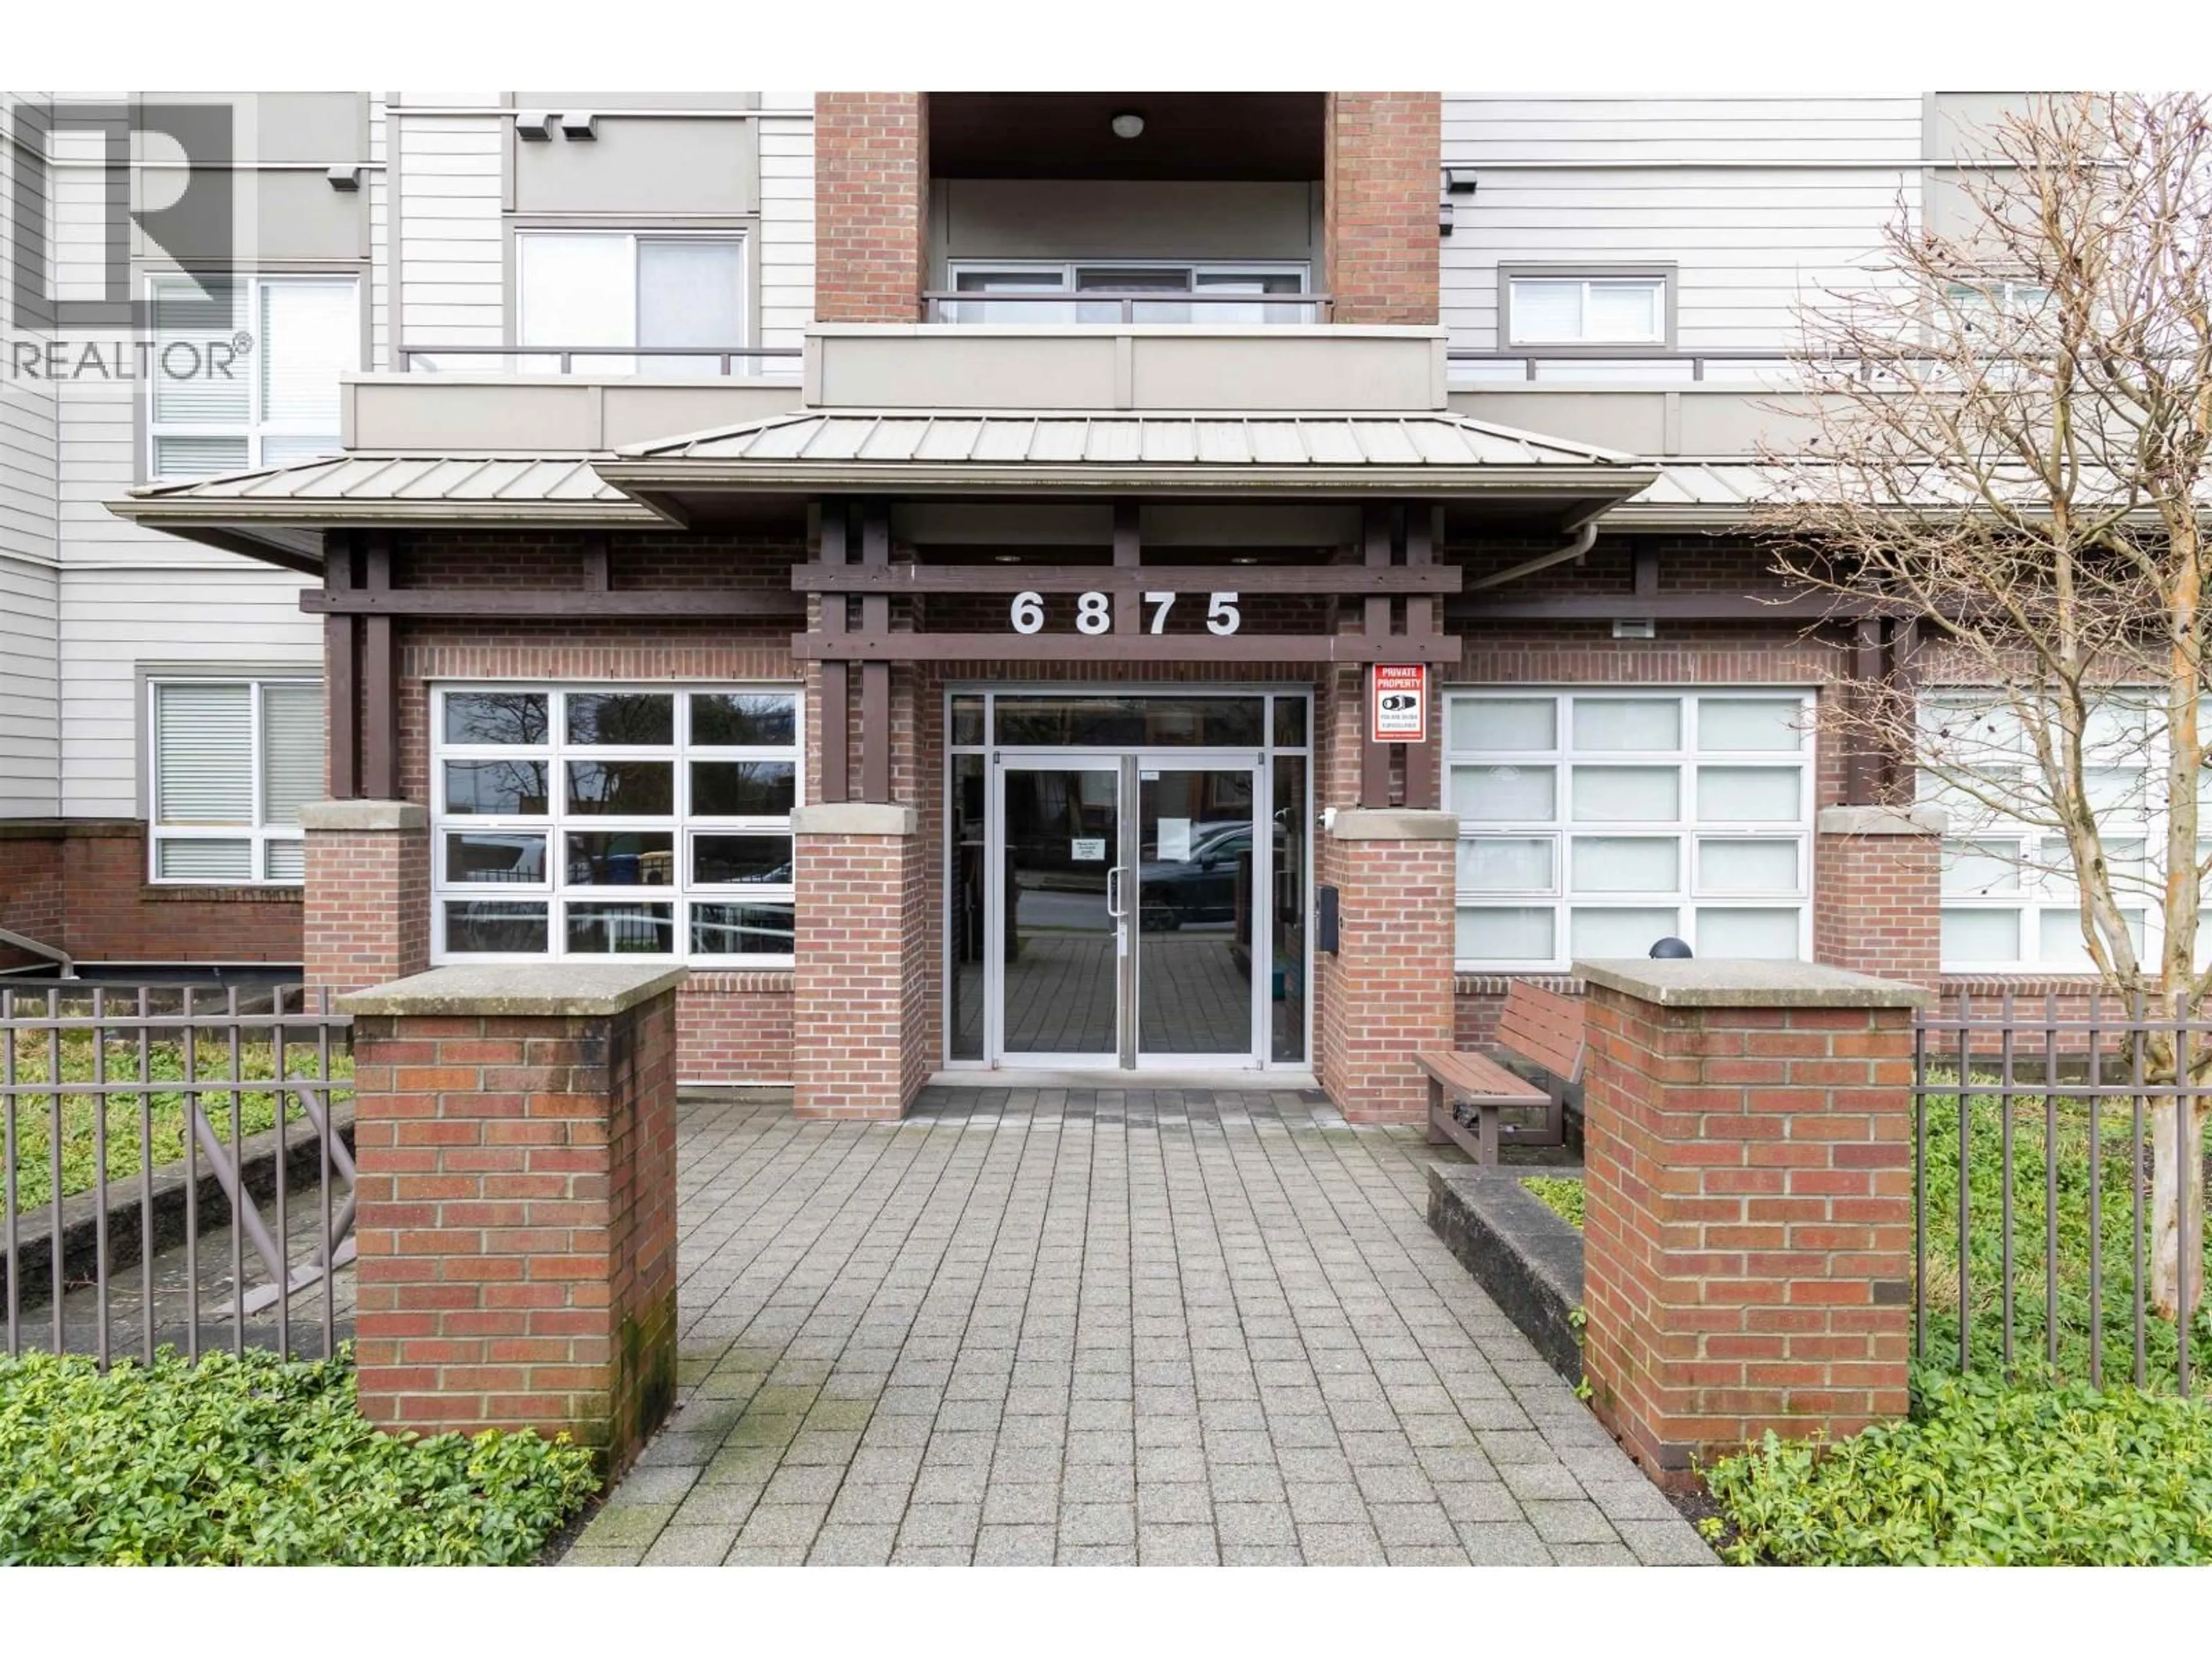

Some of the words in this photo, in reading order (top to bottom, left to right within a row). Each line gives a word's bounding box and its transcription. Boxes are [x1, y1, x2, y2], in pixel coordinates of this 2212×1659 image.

[1010, 591, 1241, 635] 6875
[1382, 668, 1416, 677] PRIVATE
[1377, 679, 1421, 688] PROPERTY
